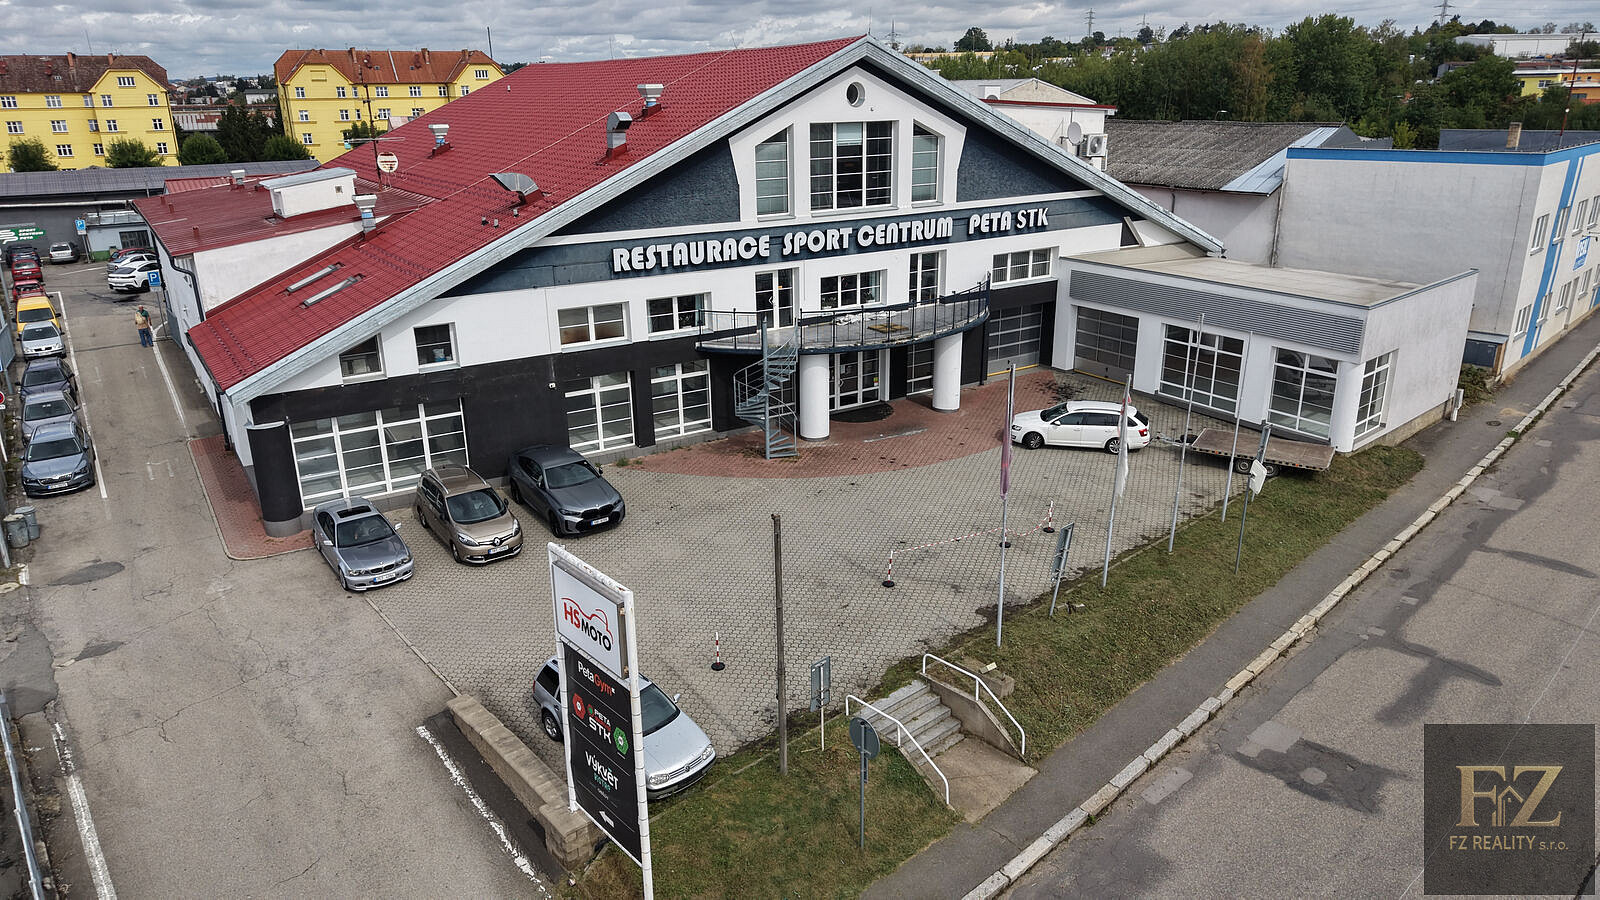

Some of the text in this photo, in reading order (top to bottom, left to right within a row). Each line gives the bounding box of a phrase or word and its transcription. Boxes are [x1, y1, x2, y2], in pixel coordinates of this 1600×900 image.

[612, 207, 1049, 272] RESTAURACE SPORT CENTRUM PETA STK
[150, 273, 157, 282] P
[563, 601, 612, 652] HS MOTO
[588, 716, 612, 744] STK
